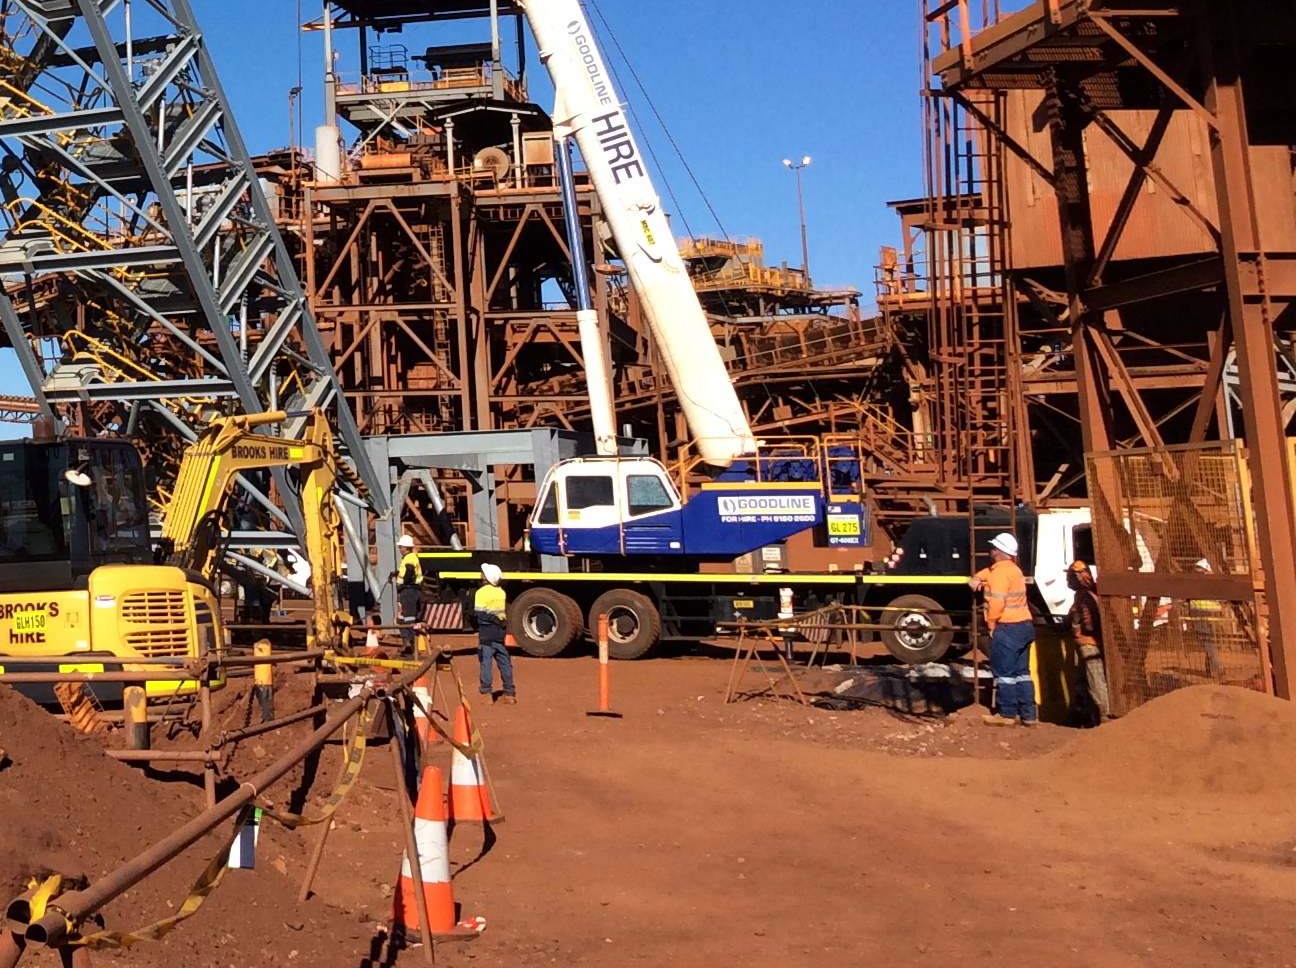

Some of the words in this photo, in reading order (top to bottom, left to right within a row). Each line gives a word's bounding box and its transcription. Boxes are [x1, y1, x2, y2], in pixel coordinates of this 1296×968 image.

[575, 34, 612, 106] GOODLINE
[591, 110, 644, 185] HIRE
[232, 445, 267, 459] BROOKS
[269, 447, 289, 460] HIRE
[738, 498, 811, 509] GOODLINE
[721, 515, 738, 523] FOR
[738, 515, 757, 523] HIRE
[761, 515, 773, 523] PH
[842, 522, 858, 533] 275
[9, 629, 46, 644] HIRE
